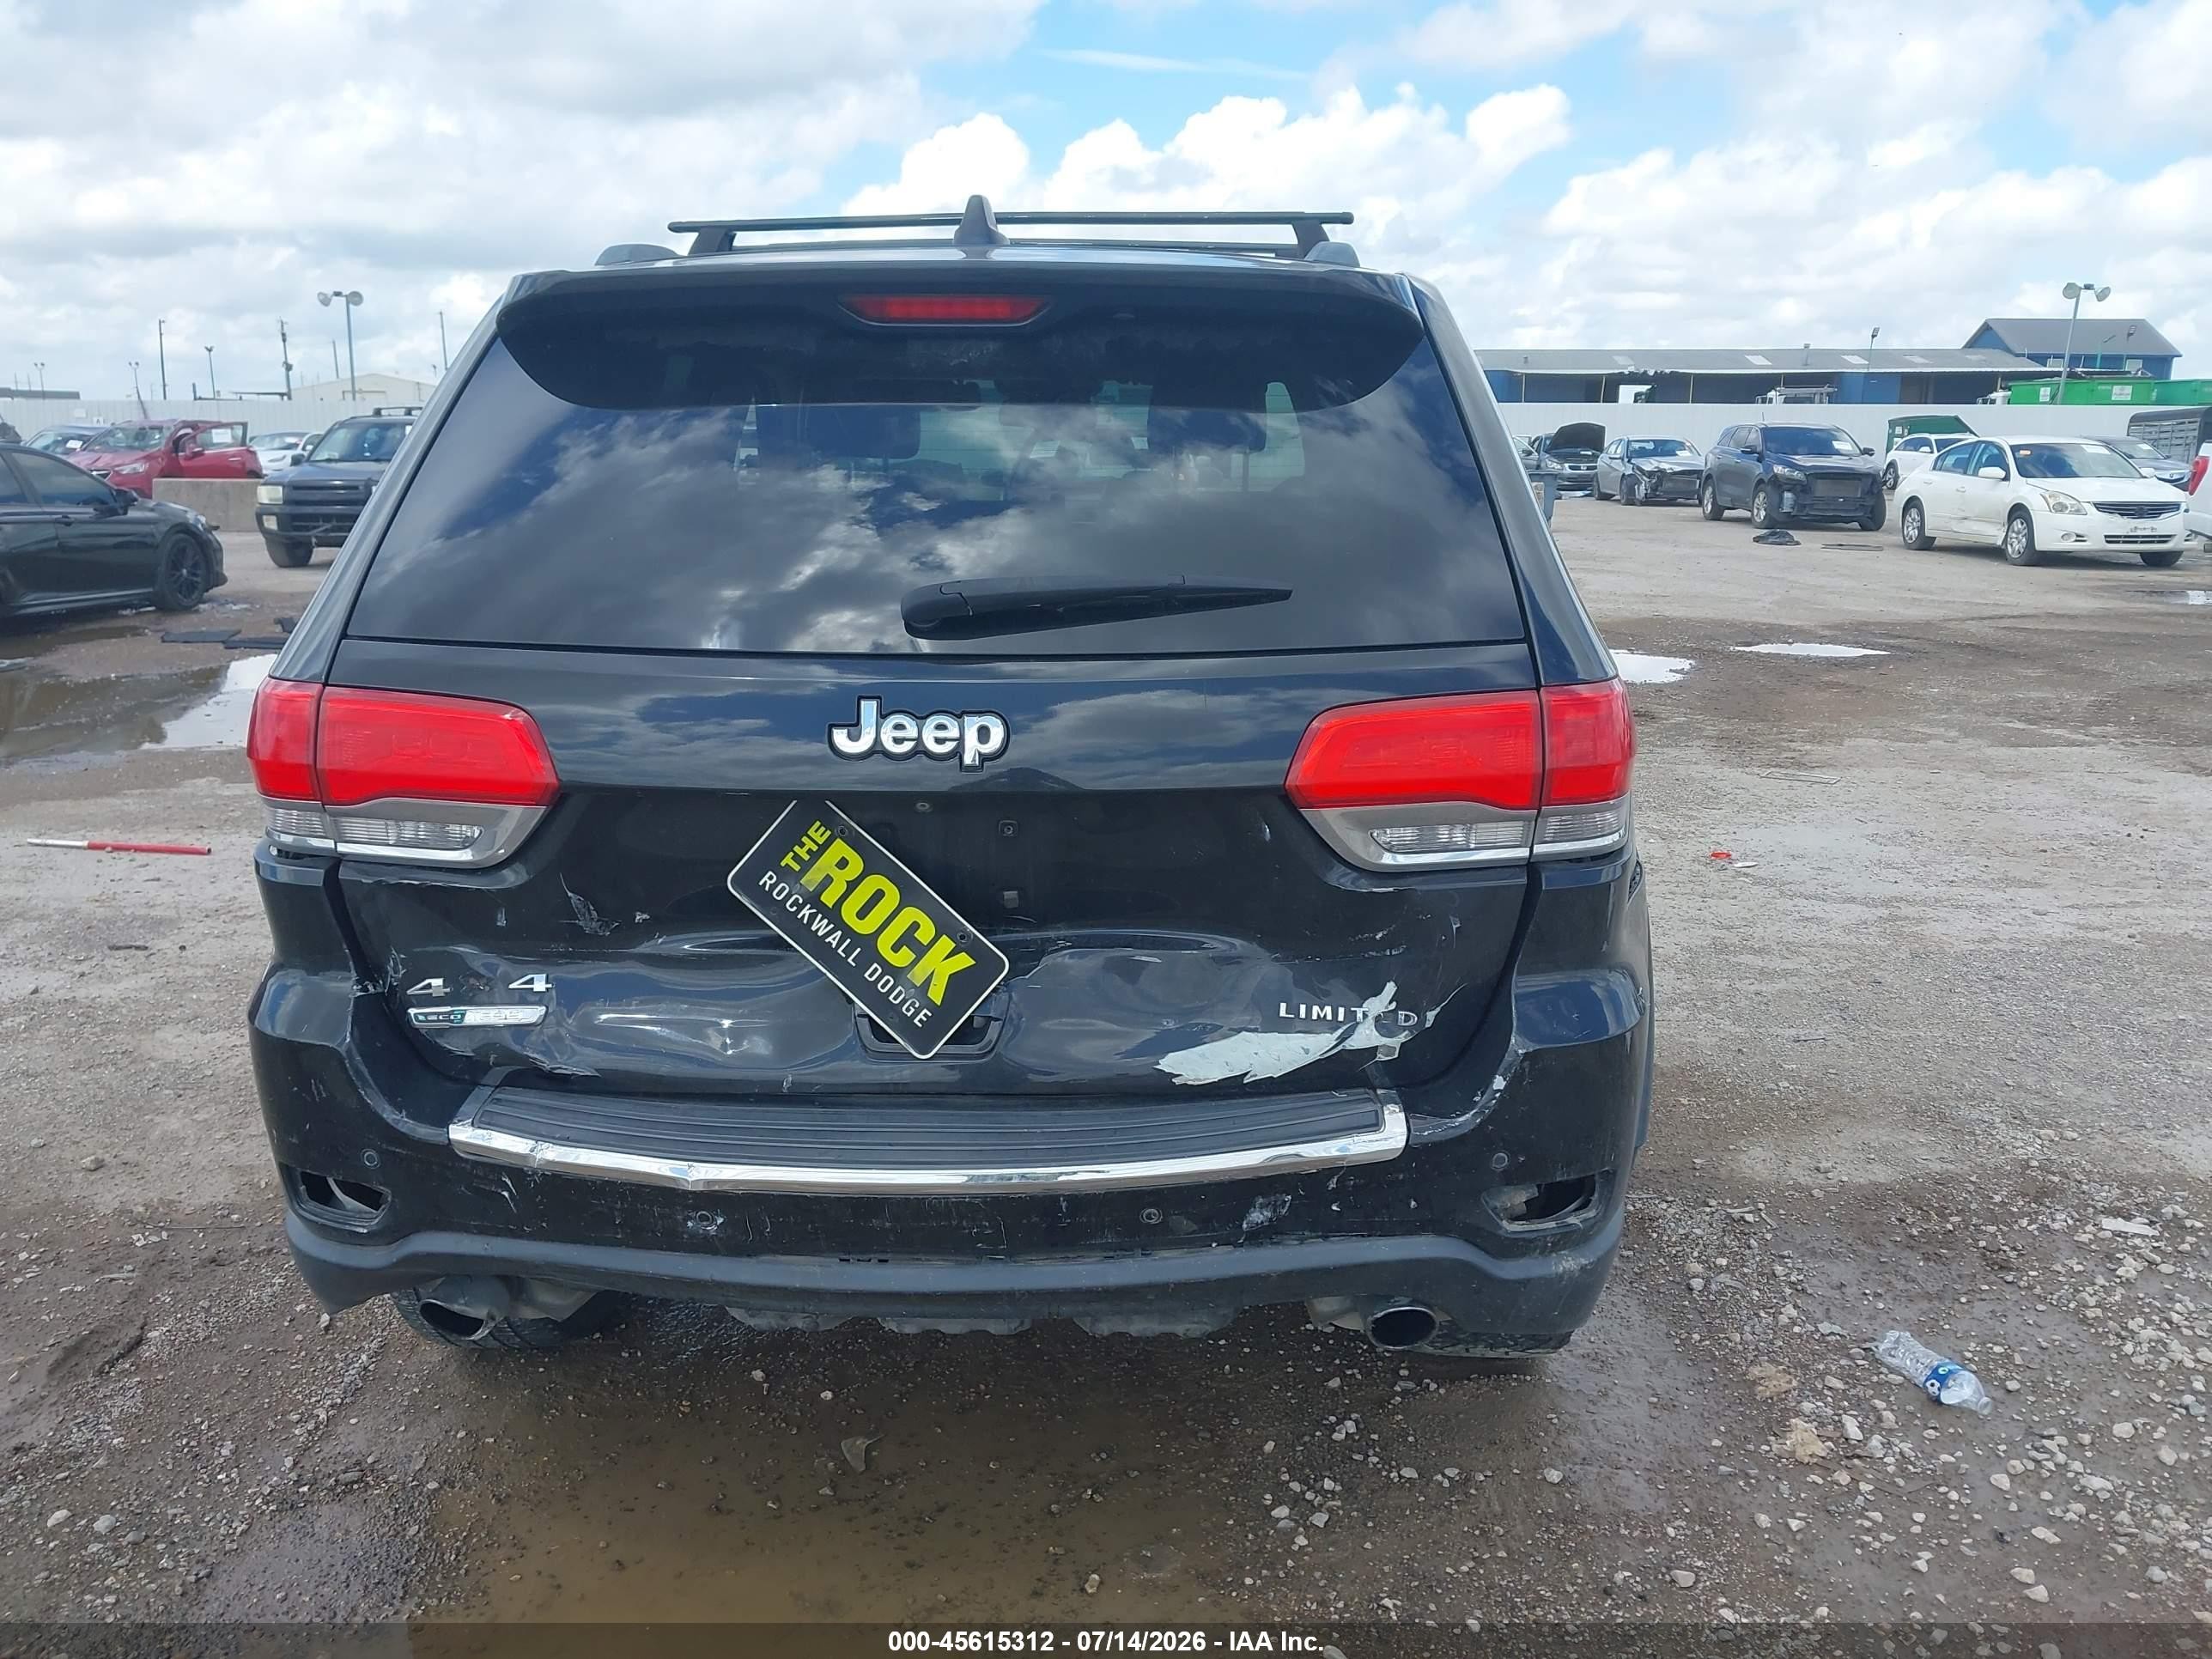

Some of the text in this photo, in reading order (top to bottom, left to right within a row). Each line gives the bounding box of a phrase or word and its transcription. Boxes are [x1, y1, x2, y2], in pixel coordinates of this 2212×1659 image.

[830, 699, 1006, 767] Jeep
[780, 820, 831, 872] THE
[758, 870, 861, 967] ROCKWALL
[799, 837, 976, 1006] ROCK
[864, 962, 933, 1028] DODGE
[1279, 1002, 1419, 1027] LIMITD
